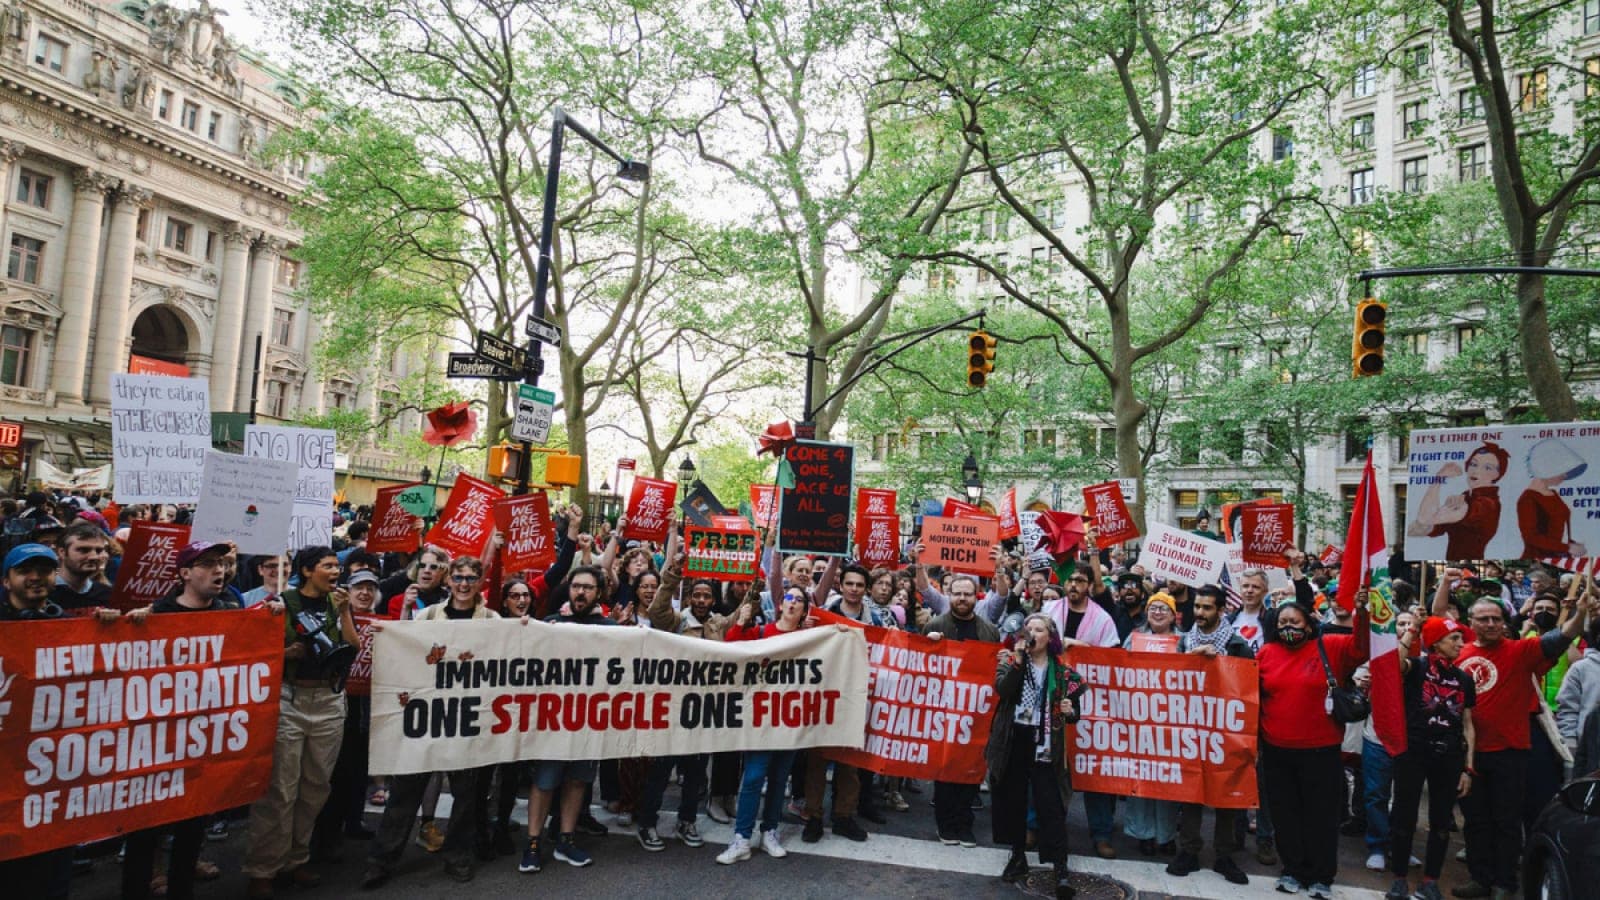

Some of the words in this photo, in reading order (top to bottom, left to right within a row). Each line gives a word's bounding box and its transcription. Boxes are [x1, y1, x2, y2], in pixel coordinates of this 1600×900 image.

[483, 339, 506, 360] Beaver
[453, 360, 495, 375] Broadway
[115, 379, 163, 406] they're
[167, 385, 205, 411] eating
[113, 409, 152, 433] THE
[517, 414, 549, 430] SHARED
[520, 425, 542, 438] LANE
[1416, 434, 1436, 444] IT'S
[1440, 432, 1477, 443] EITHER
[1481, 431, 1504, 441] ONE
[1539, 429, 1552, 438] OR
[1556, 428, 1576, 437] THE
[166, 440, 205, 466] eating
[248, 431, 289, 460] NO
[297, 433, 334, 470] ICE
[786, 446, 828, 461] COME
[834, 447, 846, 462] 4
[1411, 452, 1441, 461] FIGHT
[1444, 451, 1465, 460] FOR
[1411, 464, 1428, 473] THE
[1410, 476, 1447, 485] FUTURE
[468, 487, 490, 501] WE
[644, 485, 665, 497] WE
[785, 482, 828, 496] ACE
[1094, 491, 1110, 503] WE
[1560, 487, 1573, 496] OR
[400, 492, 425, 504] DSA
[460, 498, 490, 513] ARE
[640, 494, 665, 505] ARE
[797, 497, 825, 512] ALL
[869, 495, 885, 504] WE
[1573, 498, 1592, 508] GET
[511, 504, 534, 517] WE
[637, 503, 664, 519] THE
[866, 503, 888, 514] ARE
[1096, 501, 1117, 513] ARE
[454, 507, 487, 527] THE
[510, 513, 539, 529] ARE
[1096, 508, 1120, 524] THE
[1257, 512, 1279, 522] WE
[508, 524, 541, 540] THE
[871, 520, 888, 530] WE
[942, 523, 958, 533] TAX
[962, 525, 978, 535] THE
[1255, 521, 1283, 532] ARE
[148, 533, 177, 549] WE
[690, 531, 755, 551] FREE
[869, 529, 892, 540] ARE
[1253, 531, 1283, 543] THE
[507, 536, 547, 555] MANY.
[868, 539, 891, 550] THE
[1161, 532, 1187, 549] SEND
[1190, 541, 1208, 555] THE
[141, 547, 179, 563] ARE
[688, 548, 756, 561] MAHMOUD
[941, 547, 977, 563] RICH
[1149, 542, 1213, 571] BILLIONAIRES
[136, 561, 177, 579] THE
[688, 558, 754, 574] KHALIL
[1156, 558, 1167, 570] TO
[1168, 562, 1198, 581] MARS
[35, 643, 95, 679] NEW
[100, 638, 167, 672] YORK
[172, 634, 225, 666] CITY
[888, 645, 926, 673] YORK
[928, 653, 962, 677] CITY
[435, 657, 599, 689] IMMIGRANT
[606, 657, 624, 685] &
[633, 658, 738, 686] WORKER
[1076, 663, 1110, 685] NEW
[1114, 667, 1161, 689] YORK
[1165, 670, 1206, 692] CITY
[30, 662, 271, 732] DEMOCRATIC
[868, 666, 993, 714] EMOCRATIC
[403, 695, 481, 738] ONE
[491, 692, 671, 735] STRUGGLE
[680, 691, 743, 729] ONE
[752, 690, 840, 728] FIGHT
[1079, 688, 1245, 732] DEMOCRATIC
[865, 700, 973, 744] CIALISTS
[24, 710, 249, 786] SOCIALISTS
[866, 734, 929, 764] MERICA
[1075, 720, 1225, 765] SOCIALISTS
[1075, 753, 1097, 775] OF
[1100, 756, 1183, 784] AMERICA
[23, 794, 60, 828] OF
[65, 768, 185, 820] AMERICA
